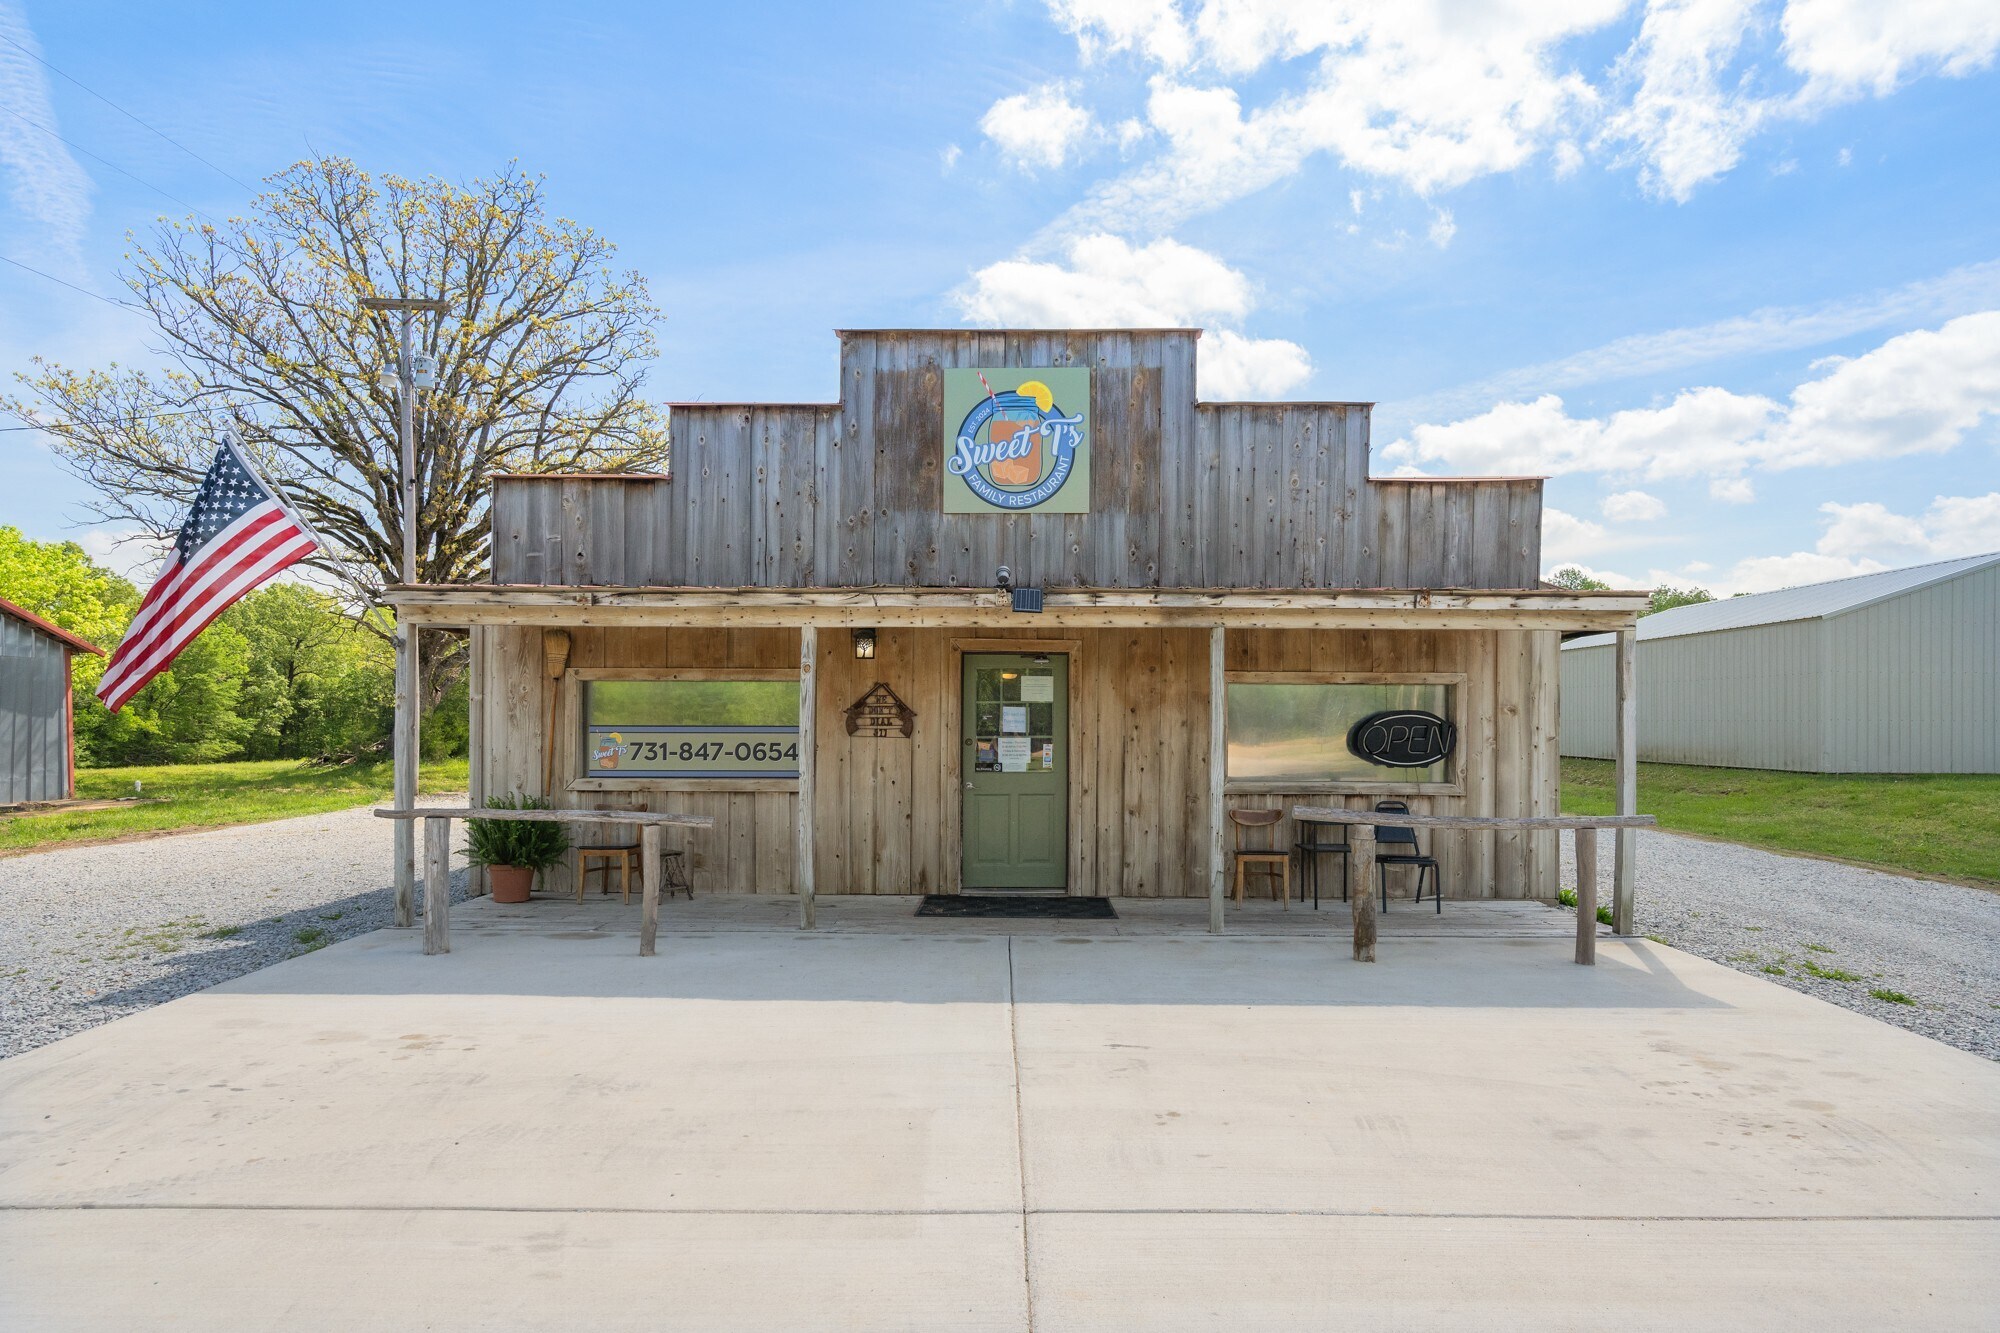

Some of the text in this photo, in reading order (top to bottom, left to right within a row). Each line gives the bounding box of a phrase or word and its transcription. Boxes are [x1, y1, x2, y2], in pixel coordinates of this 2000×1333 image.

[975, 407, 990, 421] 2024
[948, 413, 1084, 475] Sweet T's
[968, 454, 1070, 506] FAMILY RESTAURANT
[869, 717, 893, 726] DIAL
[1362, 725, 1452, 754] OPEN
[592, 747, 615, 760] Sweet
[629, 742, 799, 761] 731-847-0654
